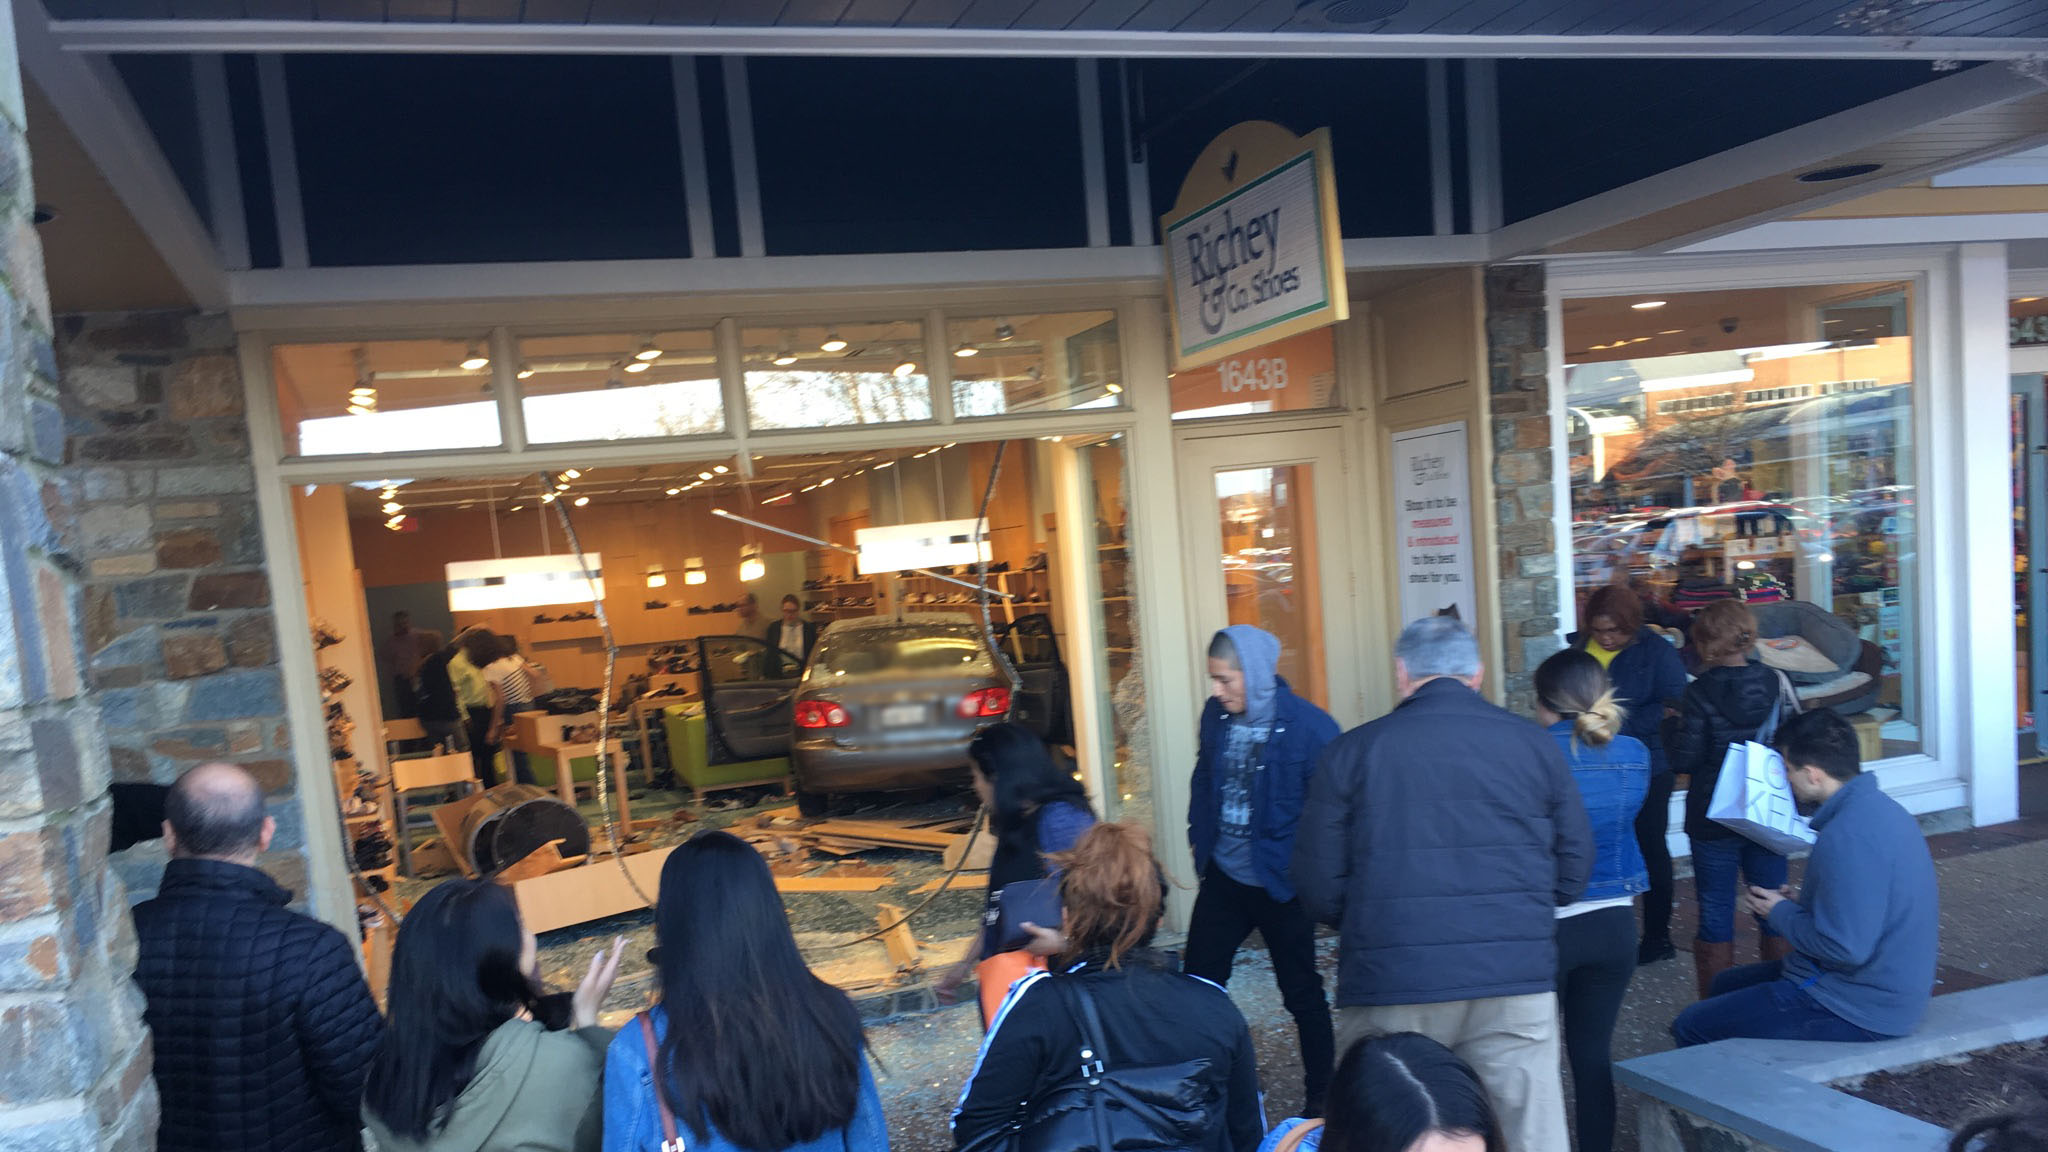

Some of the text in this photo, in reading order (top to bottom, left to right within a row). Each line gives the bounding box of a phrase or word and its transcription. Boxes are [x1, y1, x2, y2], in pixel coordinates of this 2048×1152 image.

[1186, 208, 1280, 287] Richey
[1252, 266, 1300, 304] Shoes
[1217, 357, 1288, 393] 1643B
